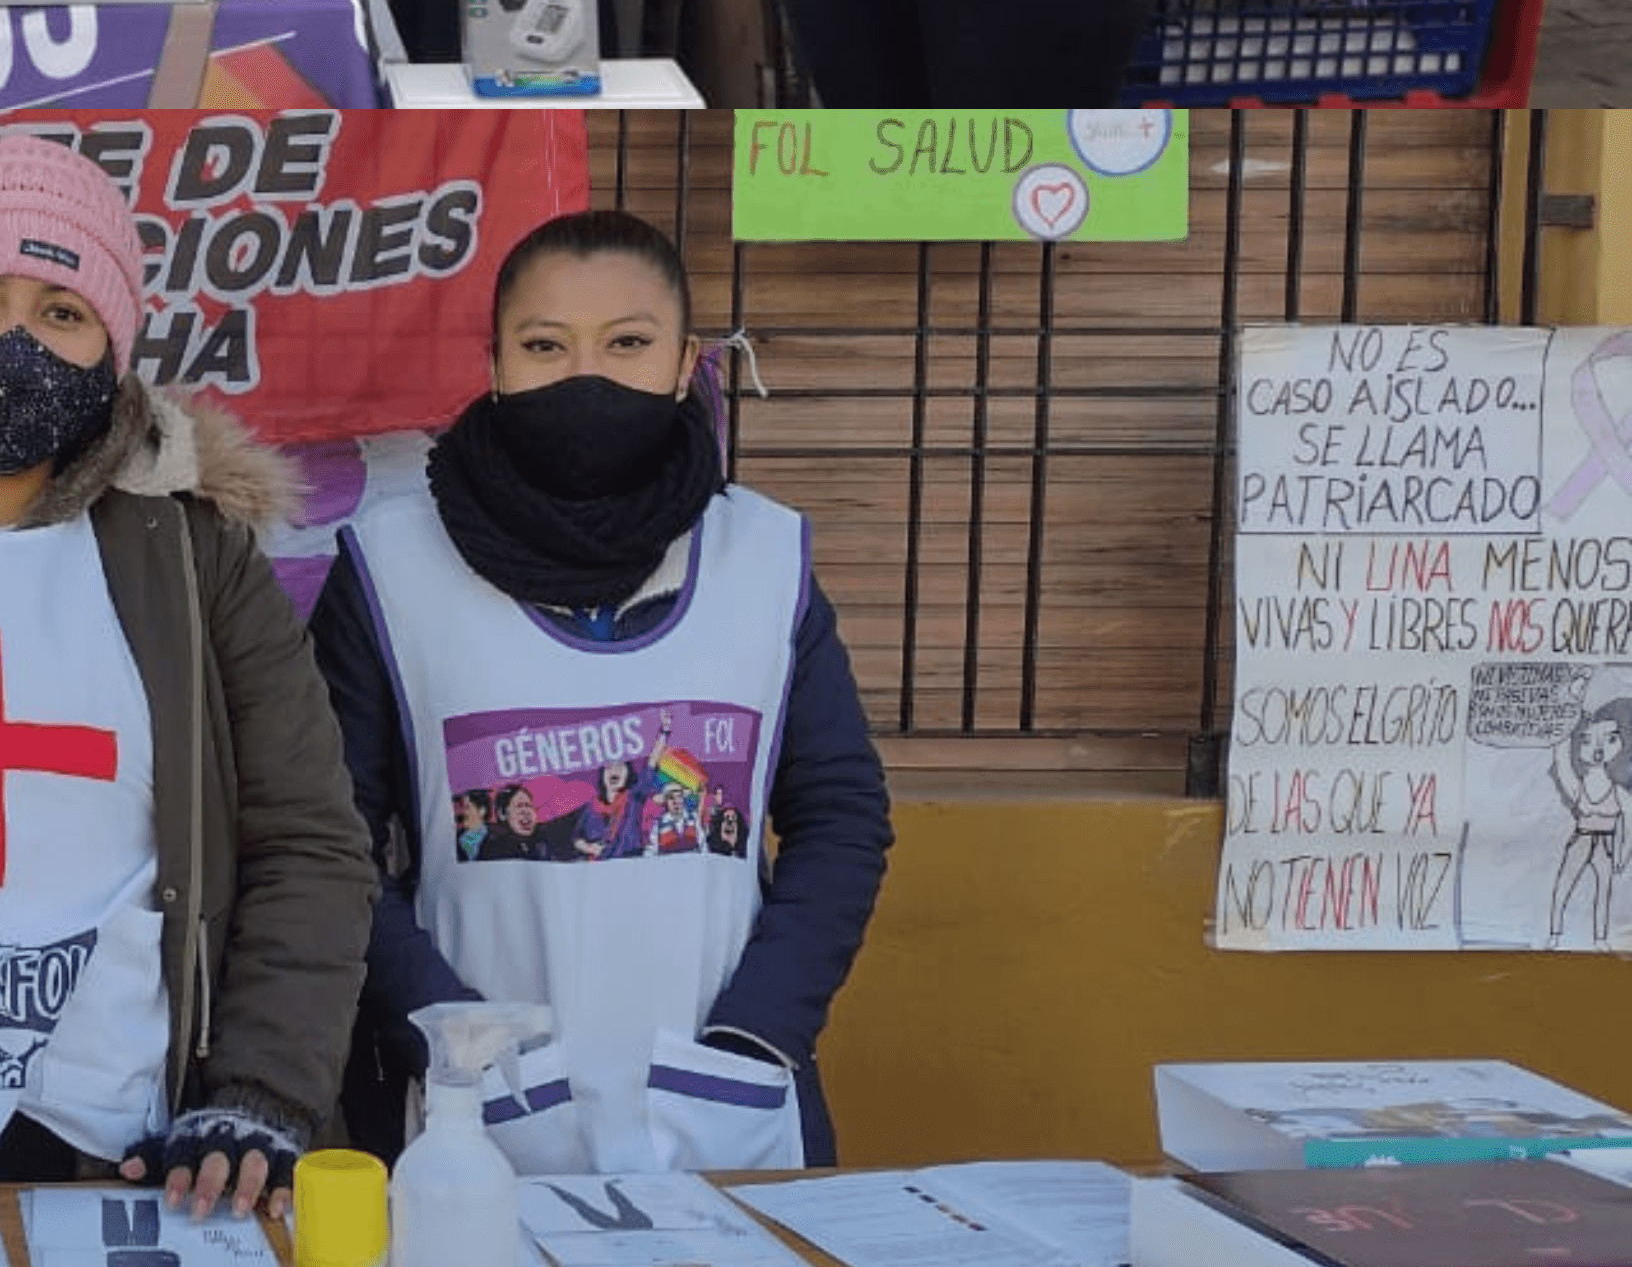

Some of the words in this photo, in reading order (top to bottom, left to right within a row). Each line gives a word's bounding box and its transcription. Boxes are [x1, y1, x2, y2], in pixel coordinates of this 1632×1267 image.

[166, 110, 342, 210] DE
[749, 119, 829, 177] FOL
[868, 116, 1034, 176] SALUD
[1328, 328, 1384, 372] NO
[1396, 329, 1450, 373] ES
[1246, 378, 1333, 416] CASO
[1292, 423, 1345, 467] SE
[1355, 424, 1488, 470] LLAMA
[1297, 540, 1344, 591] NI
[1366, 539, 1453, 592] UNA
[1482, 536, 1632, 592] MENOS
[1239, 597, 1334, 652] VIVAS
[1342, 598, 1360, 652] Y
[1485, 598, 1547, 655] NOS
[494, 715, 646, 778] GÉNEROS
[1237, 684, 1347, 748] SOMOS
[1228, 769, 1261, 836] DE
[1328, 767, 1394, 836] QUE
[1403, 770, 1437, 838] YA
[1224, 859, 1276, 933] NO
